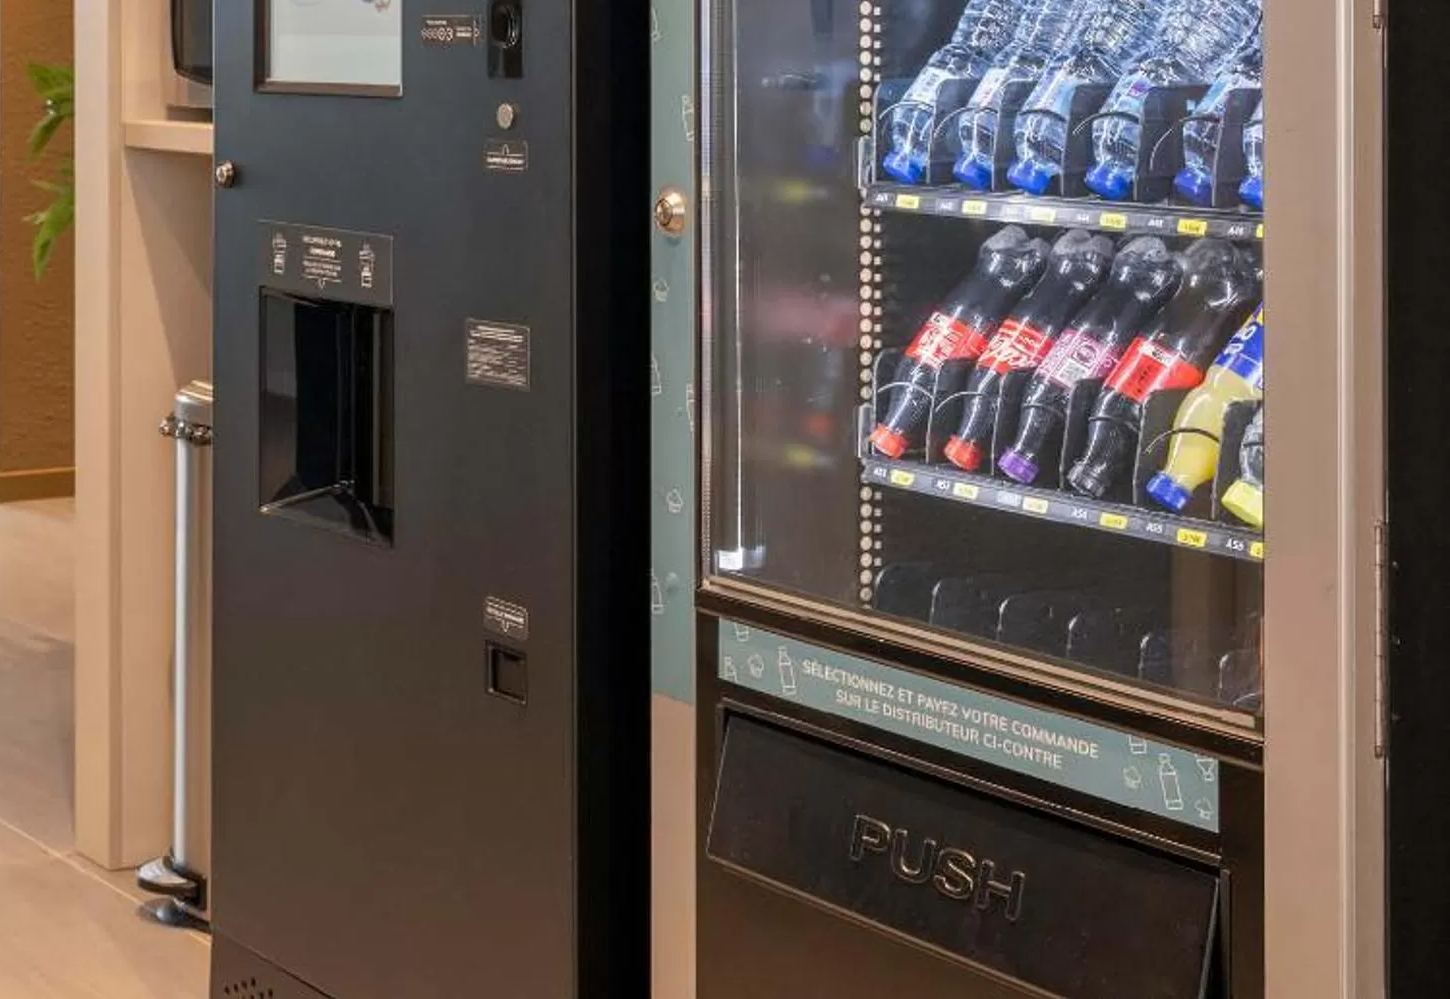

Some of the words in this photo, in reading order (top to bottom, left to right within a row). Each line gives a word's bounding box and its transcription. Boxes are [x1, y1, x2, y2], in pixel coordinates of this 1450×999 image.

[835, 688, 862, 709] SUR
[865, 698, 880, 714] LE
[882, 702, 980, 745] DISTRIBUTEUR
[983, 732, 1063, 770] CI-CONTRE
[898, 686, 914, 705] ET
[917, 693, 959, 718] PAYEZ
[961, 706, 1009, 732] VOTRE
[1011, 719, 1100, 760] COMMANDE
[849, 812, 1027, 922] PUSH
